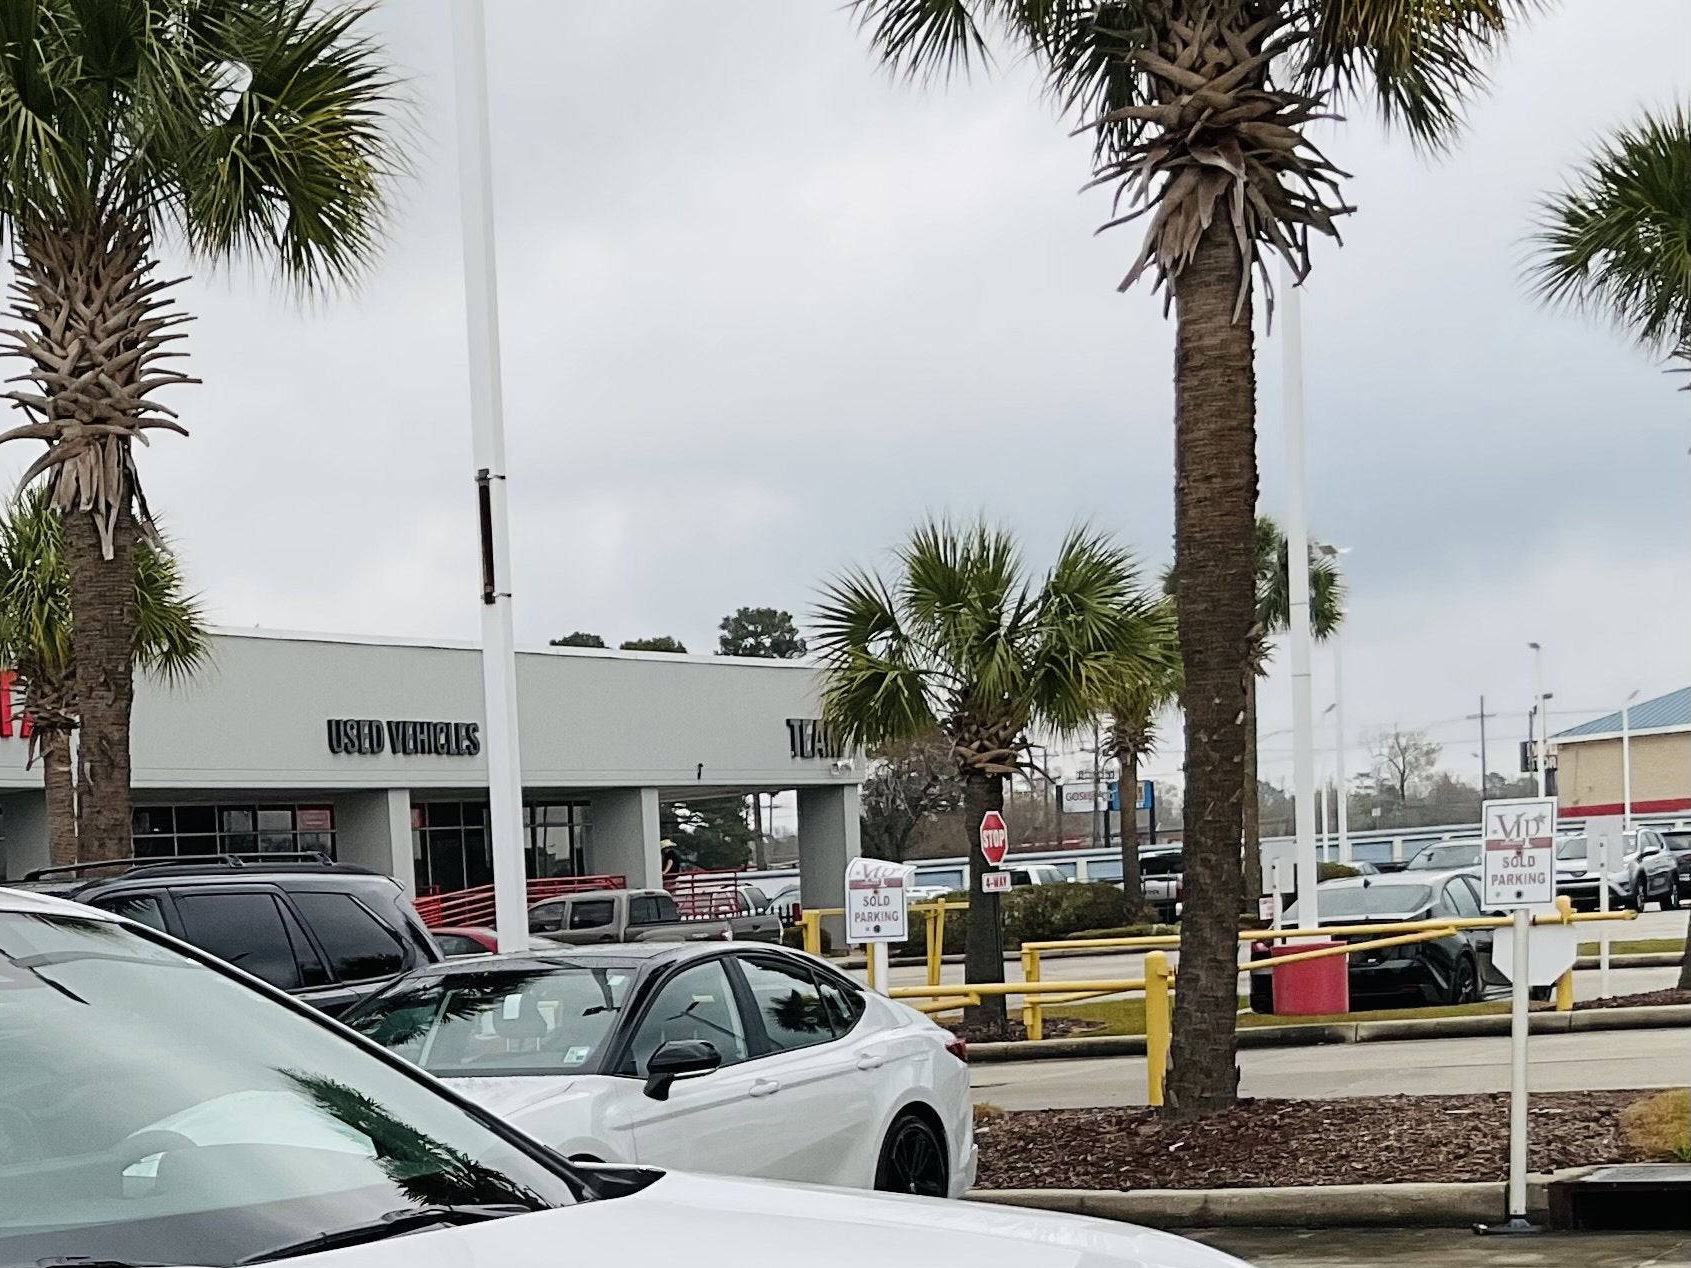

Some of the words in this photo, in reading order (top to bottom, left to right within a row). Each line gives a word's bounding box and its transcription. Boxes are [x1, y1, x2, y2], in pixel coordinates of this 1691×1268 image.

[327, 719, 385, 754] USED
[386, 720, 481, 756] VEHICLES
[982, 829, 1005, 848] STOP
[1502, 855, 1536, 868] SOLD
[985, 876, 1007, 888] 4-WAY
[1491, 872, 1546, 886] PARKING
[862, 895, 890, 907] SOLD
[854, 910, 899, 922] PARKING
